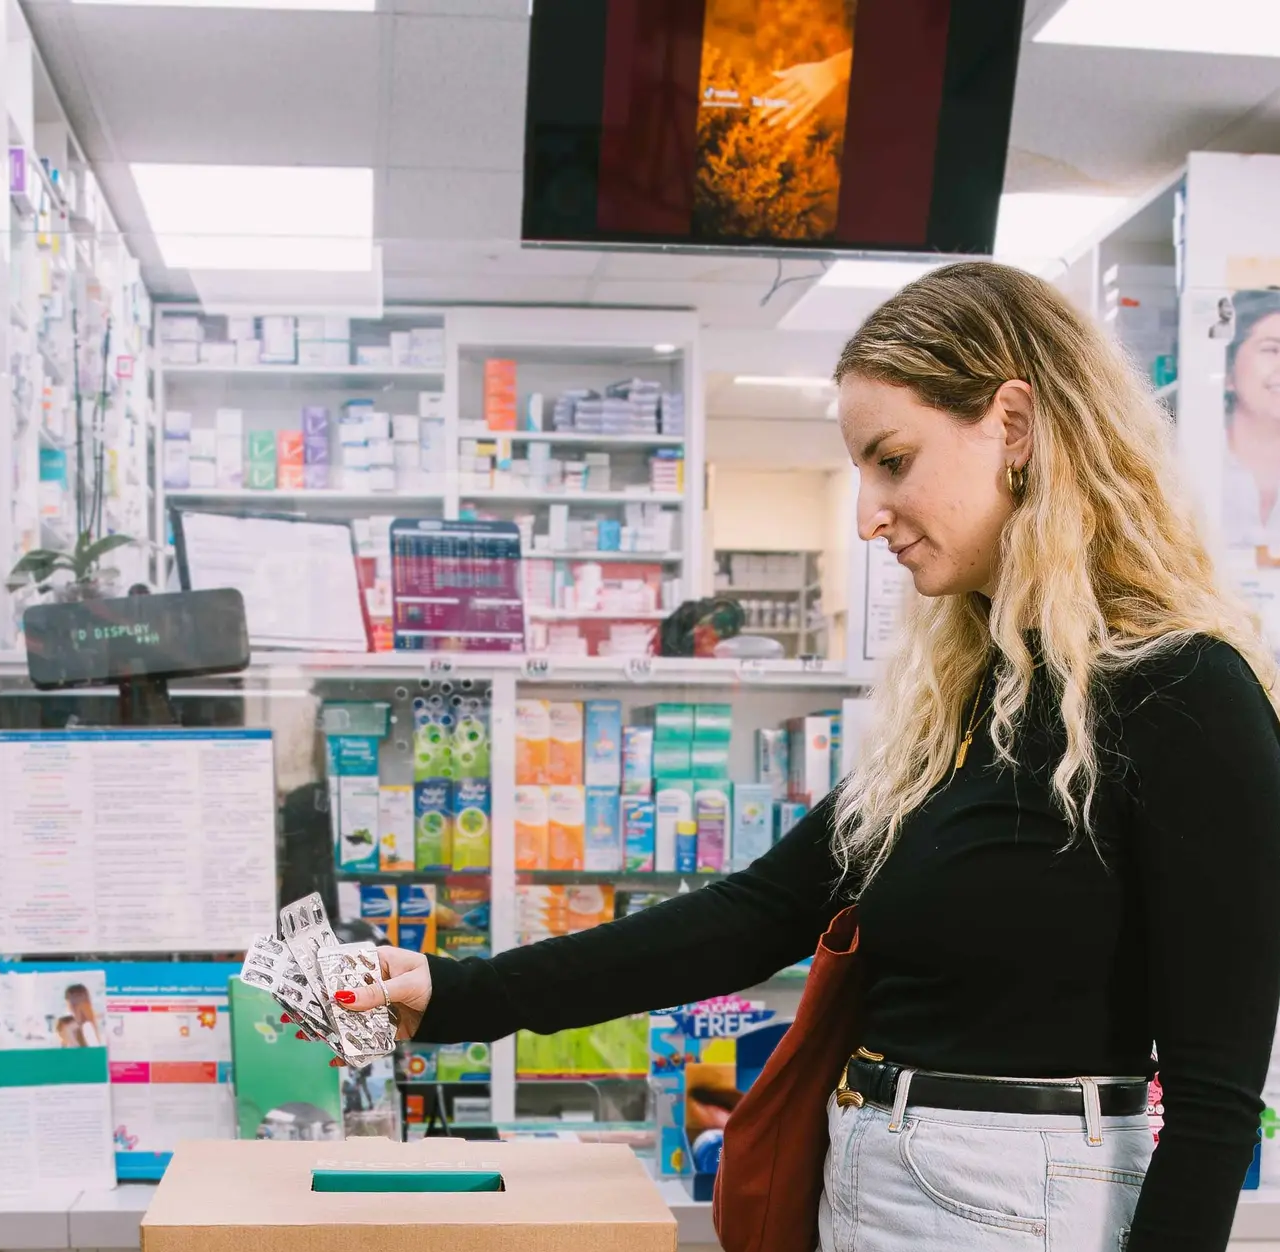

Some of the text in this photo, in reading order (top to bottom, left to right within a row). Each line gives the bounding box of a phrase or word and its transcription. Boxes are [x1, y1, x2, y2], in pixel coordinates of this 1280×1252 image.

[94, 622, 151, 640] DISPLAY
[526, 659, 548, 673] FLU
[693, 1013, 754, 1038] FREE
